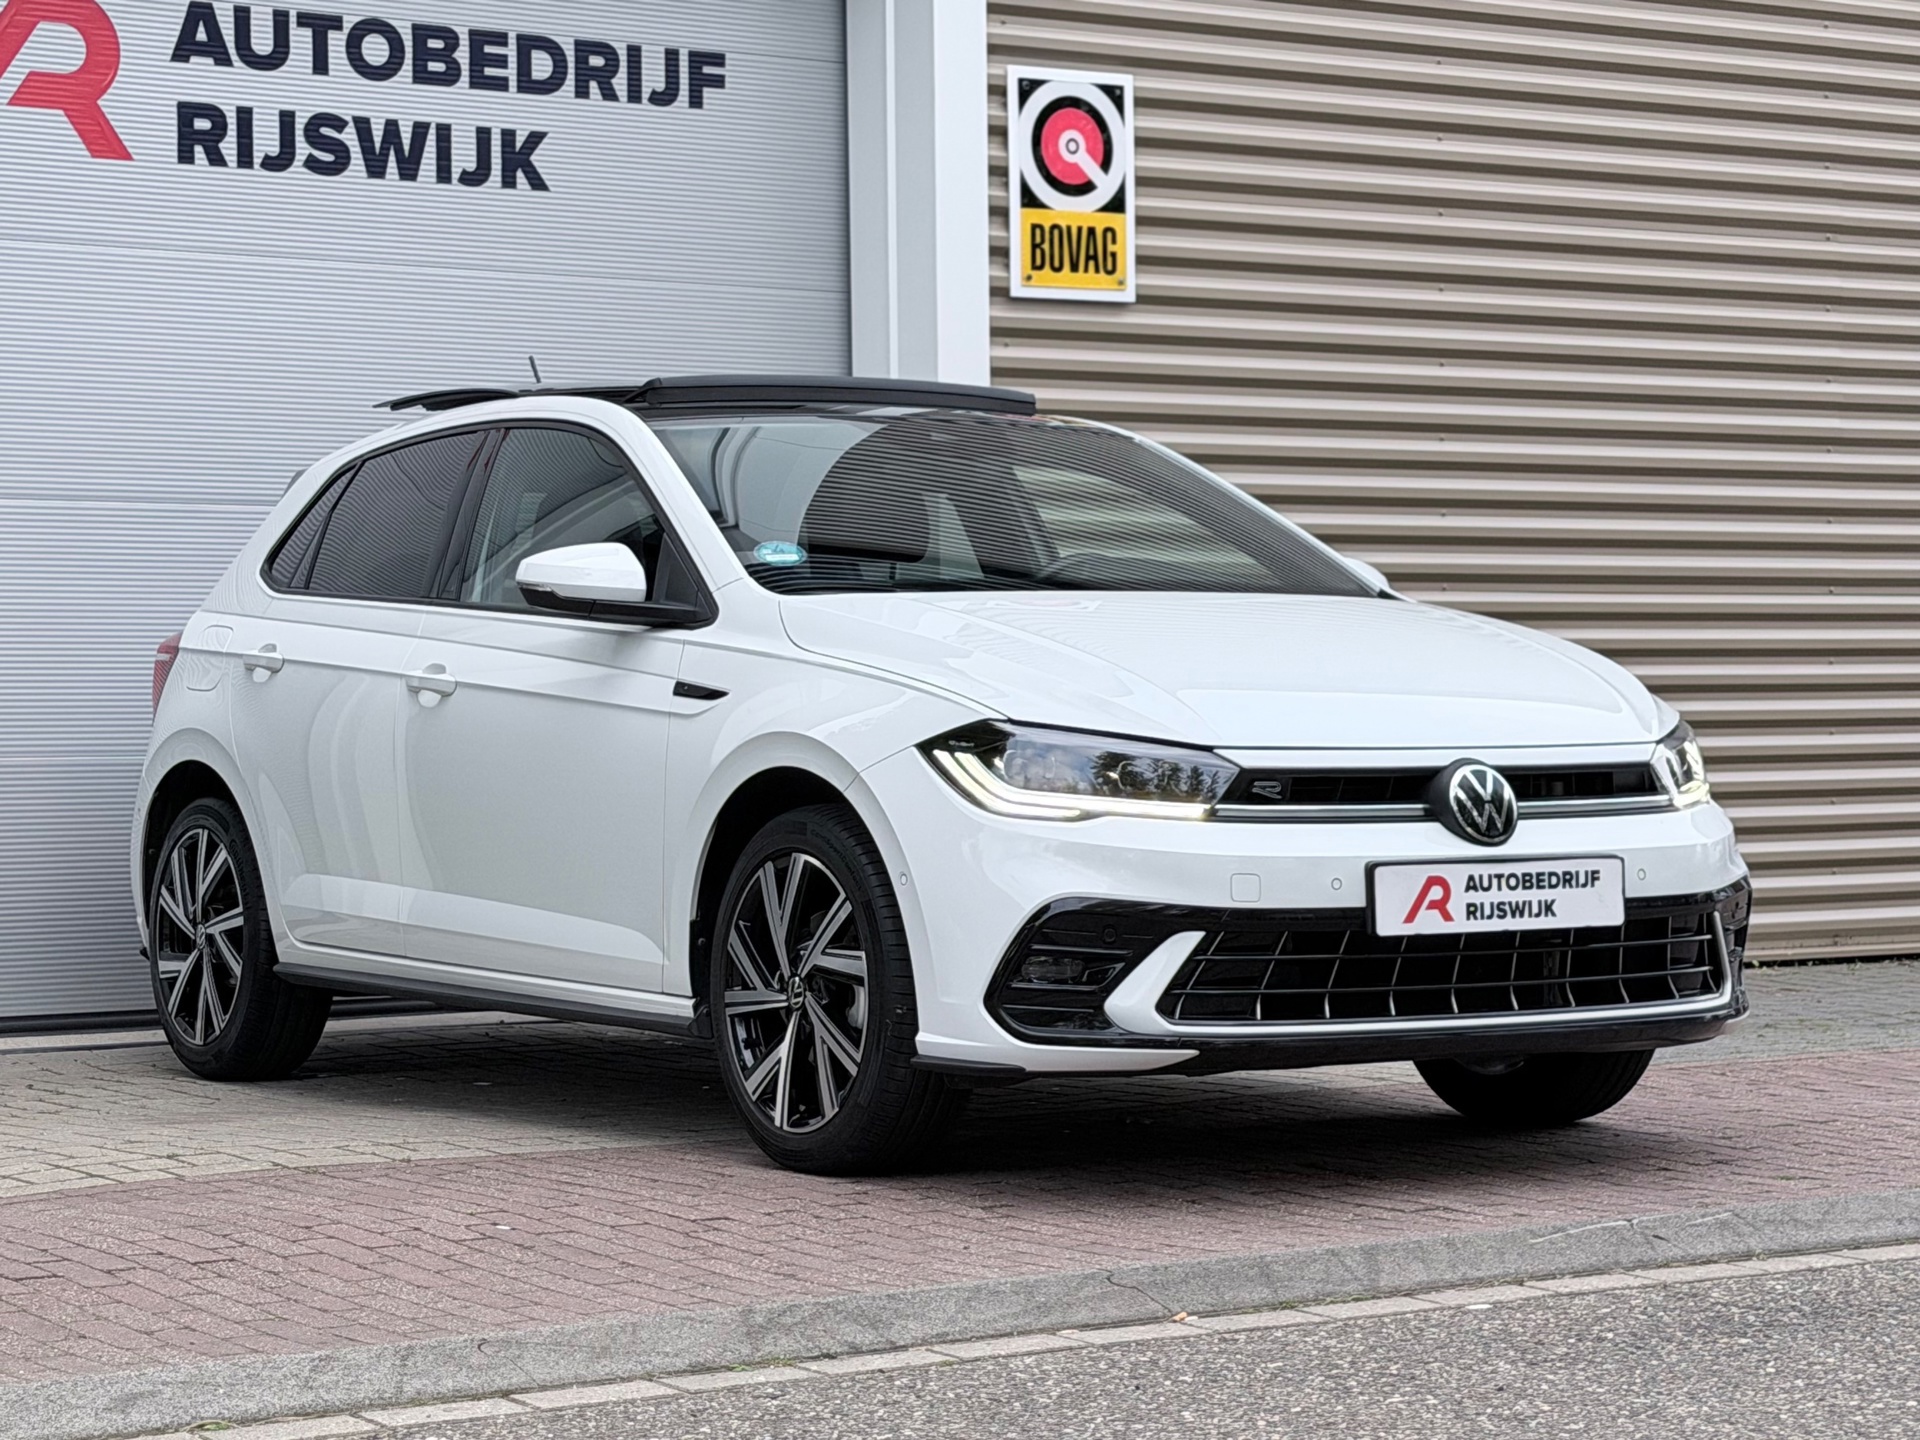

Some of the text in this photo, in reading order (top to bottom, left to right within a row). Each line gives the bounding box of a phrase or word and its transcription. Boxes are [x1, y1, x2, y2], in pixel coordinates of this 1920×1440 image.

[170, 0, 726, 110] AUTOBEDRIJF
[176, 101, 550, 192] RIJSWIJK
[1030, 222, 1118, 276] BOVAG
[1464, 869, 1601, 893] AUTOBEDRIJF
[1465, 898, 1557, 921] RIJSWIJK
